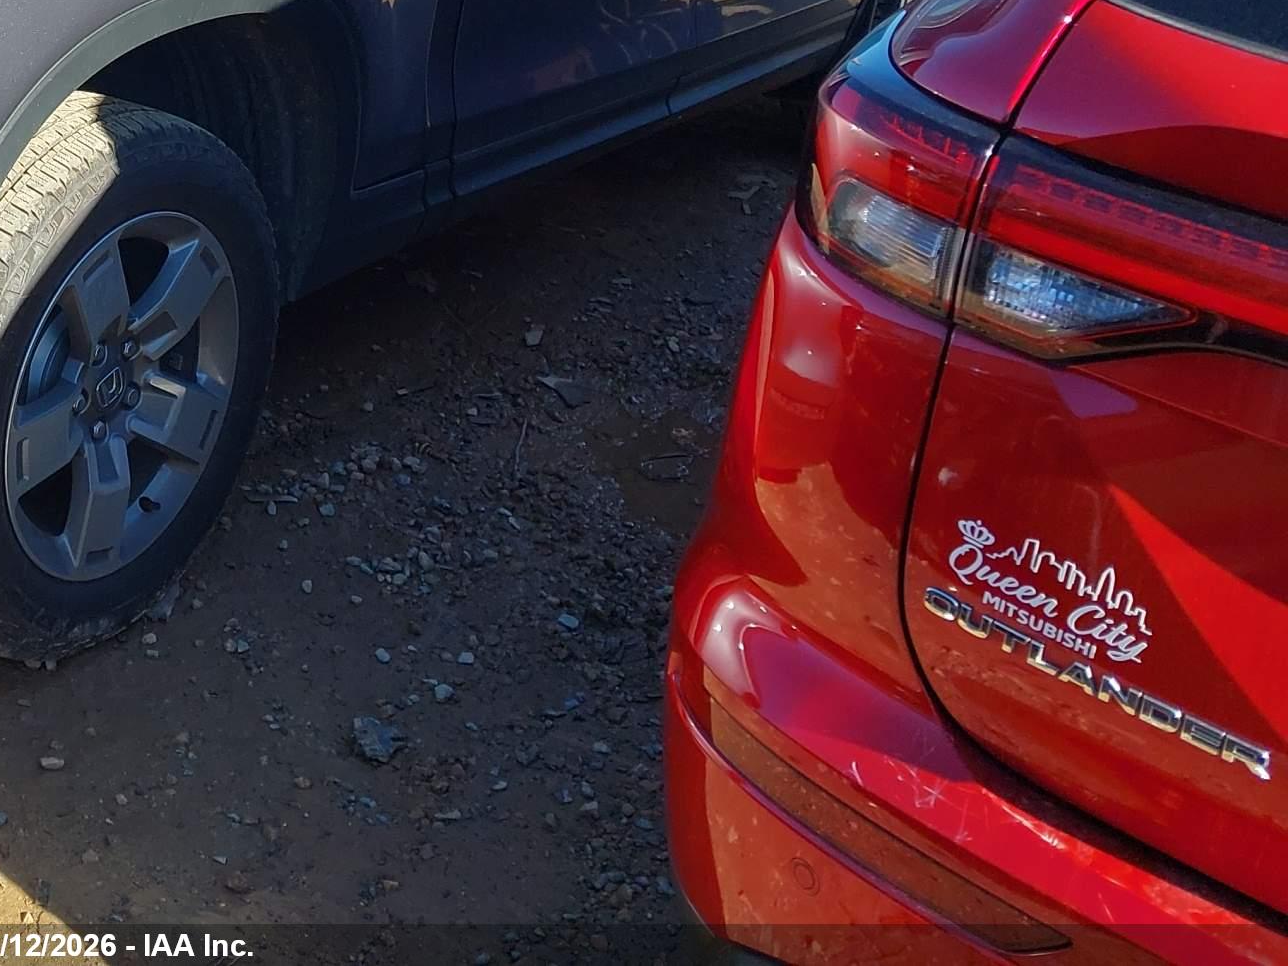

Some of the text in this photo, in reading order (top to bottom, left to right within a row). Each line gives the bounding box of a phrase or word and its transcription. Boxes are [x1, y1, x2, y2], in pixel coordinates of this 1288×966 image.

[948, 541, 1149, 664] Queen City
[982, 590, 1098, 660] MITSUBISHI
[923, 586, 1272, 781] OUTLANDER
